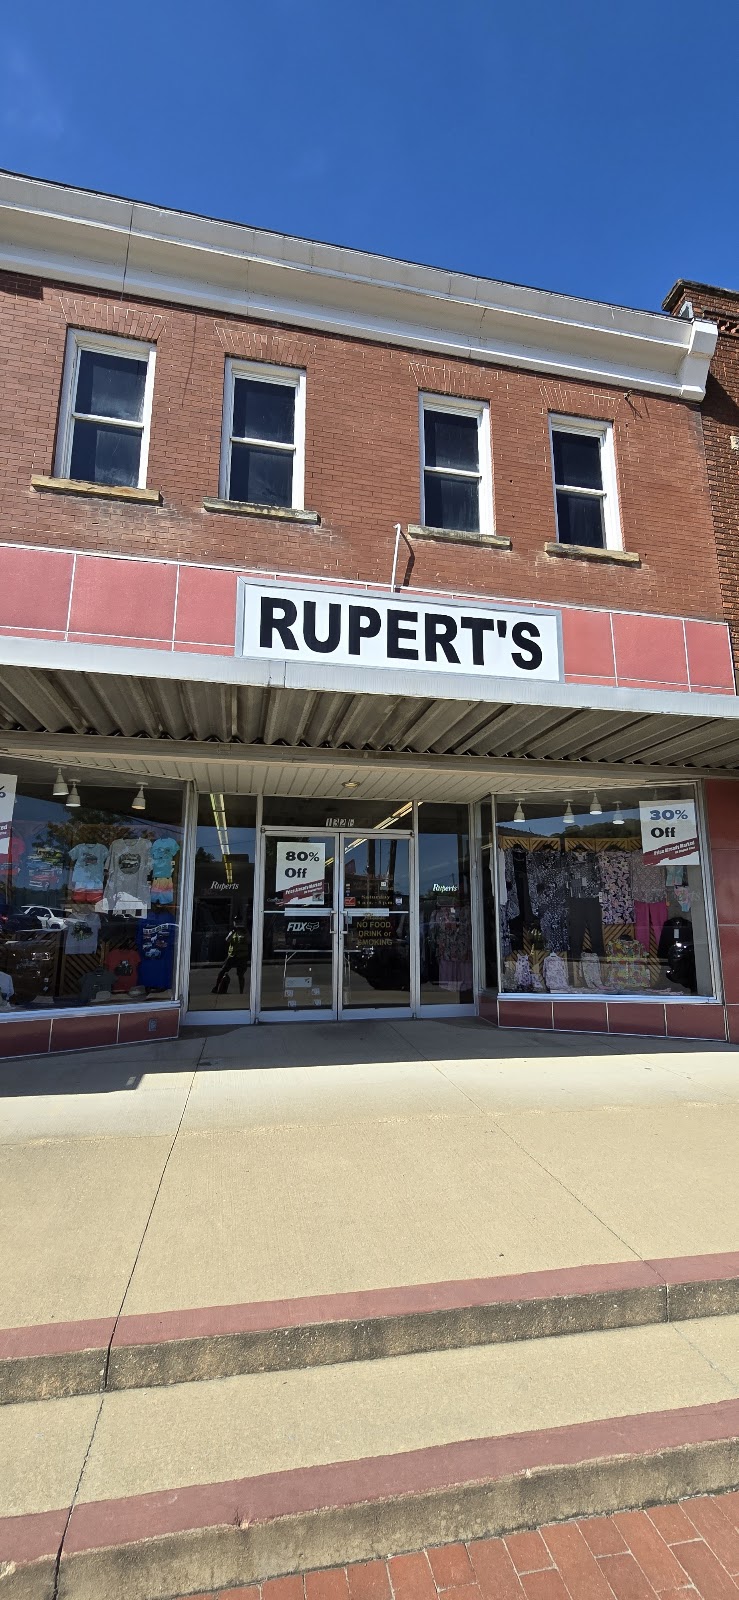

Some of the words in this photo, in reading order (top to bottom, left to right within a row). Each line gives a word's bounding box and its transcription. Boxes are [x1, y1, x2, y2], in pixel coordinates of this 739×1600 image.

[259, 596, 542, 670] RUPERT'S
[650, 809, 688, 820] 30%
[651, 827, 675, 838] Off
[285, 851, 319, 861] 80%
[285, 868, 307, 878] Off
[210, 880, 239, 891] Ruperts
[432, 883, 458, 893] Ruperts
[286, 921, 307, 932] FOX
